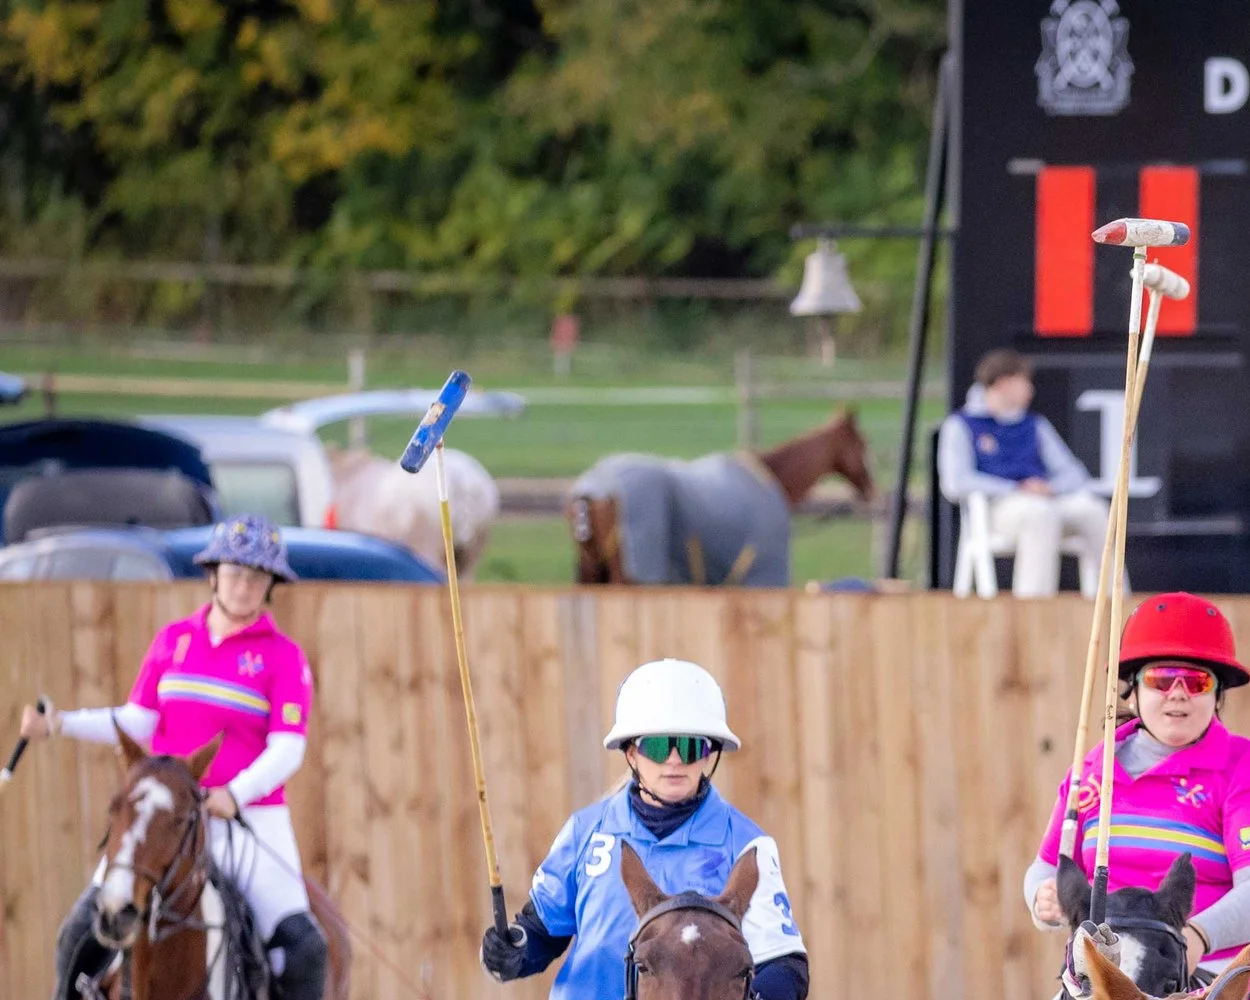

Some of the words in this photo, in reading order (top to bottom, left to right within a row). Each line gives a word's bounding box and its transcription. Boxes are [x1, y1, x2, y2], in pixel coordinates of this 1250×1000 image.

[1075, 389, 1163, 498] 1
[585, 832, 615, 877] 3
[773, 891, 800, 937] 3
